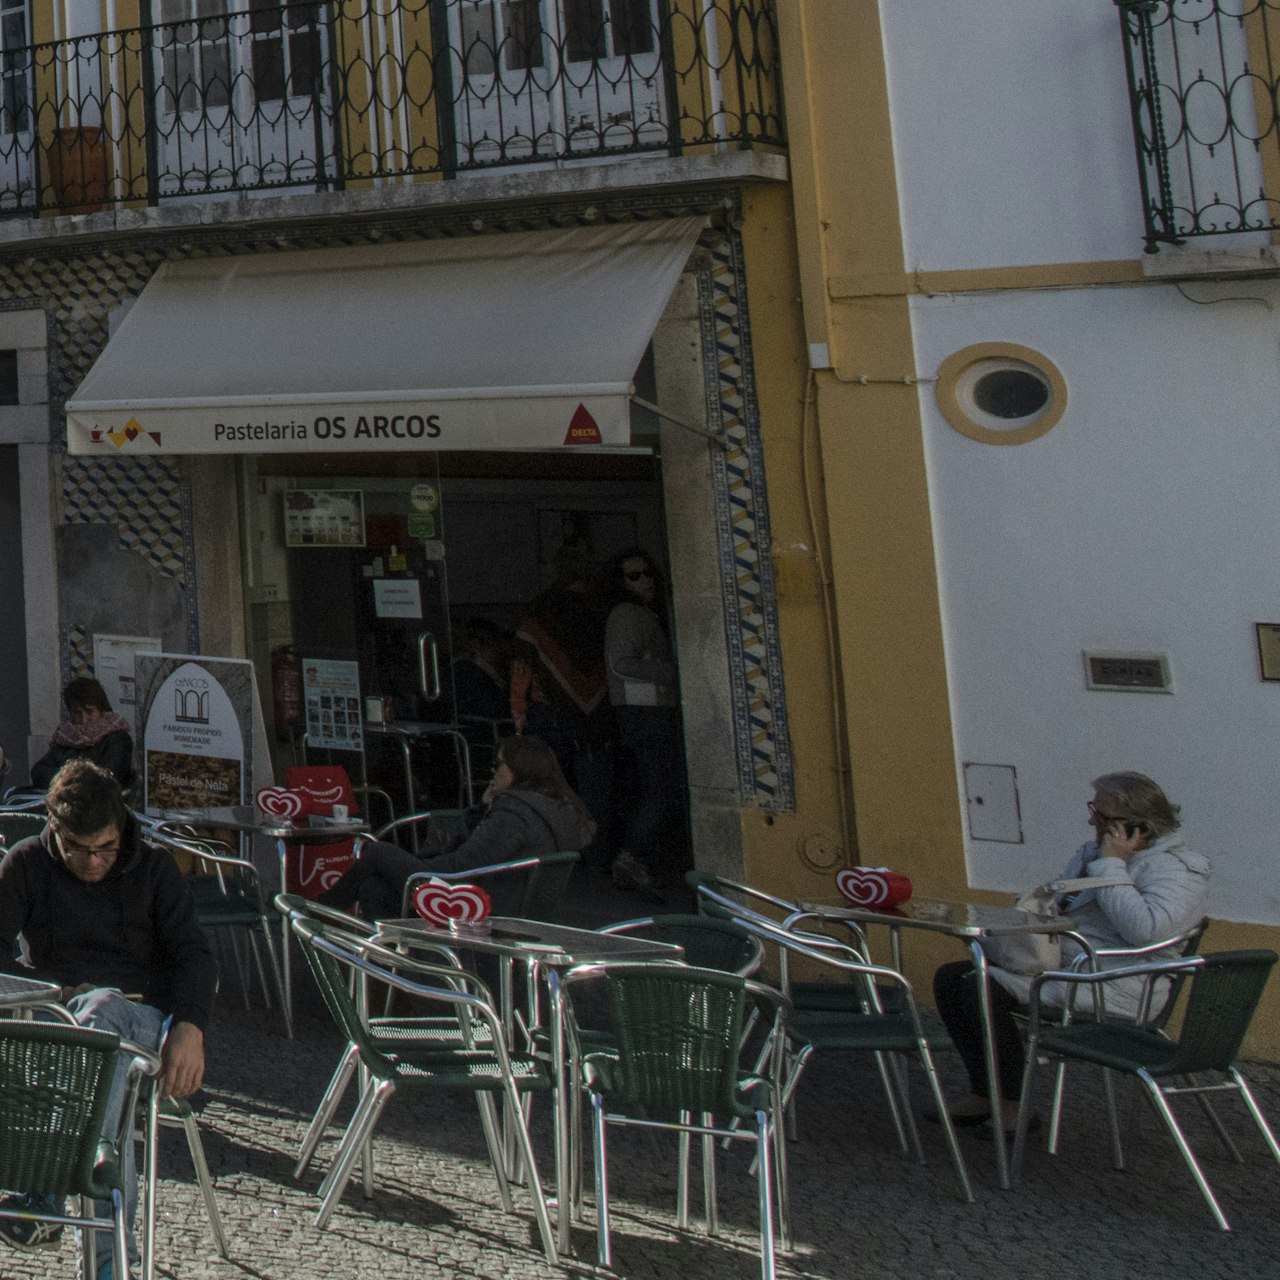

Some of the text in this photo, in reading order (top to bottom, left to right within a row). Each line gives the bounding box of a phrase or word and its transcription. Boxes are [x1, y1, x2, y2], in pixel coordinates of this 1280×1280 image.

[214, 415, 442, 440] Pastelaria OS ARCOS
[571, 428, 598, 437] DELTA
[163, 724, 192, 734] FABRICO
[173, 734, 212, 745] HOMEMADE
[158, 773, 229, 792] Pastel de Nata
